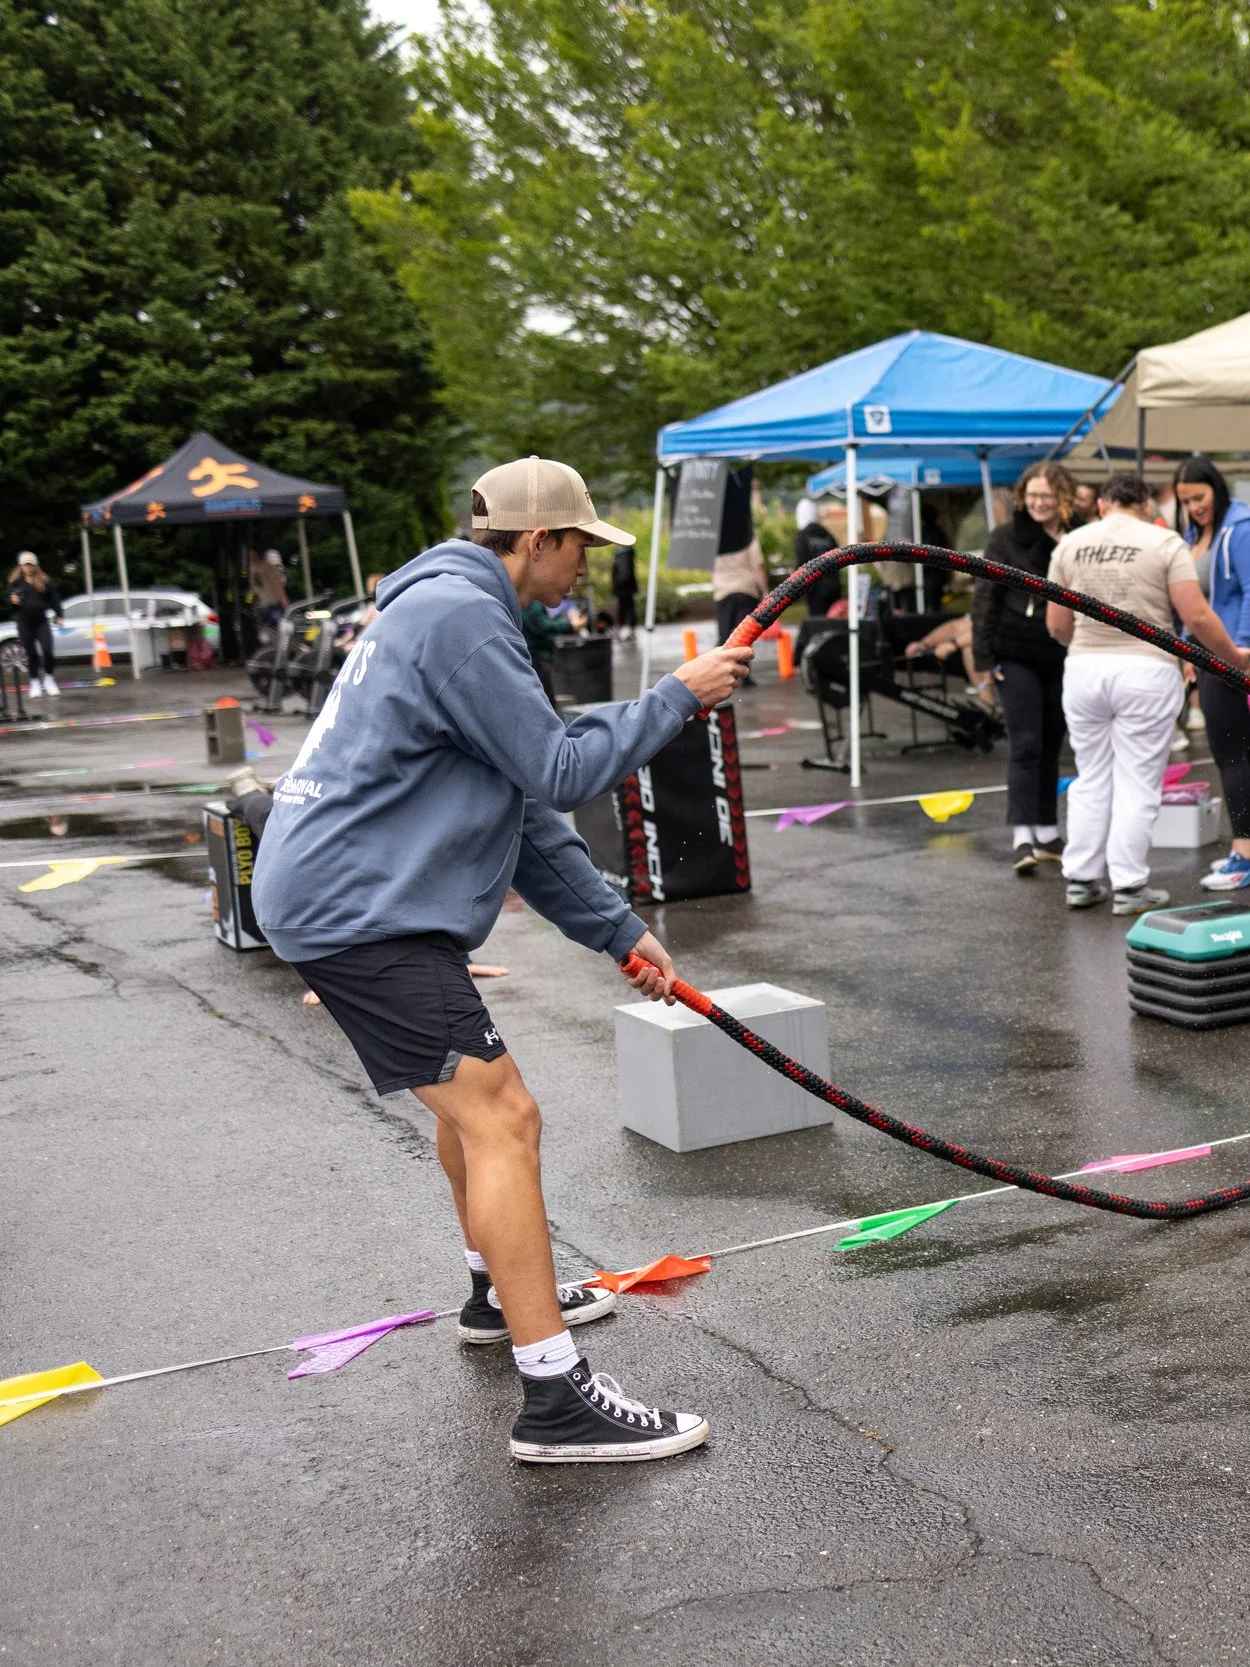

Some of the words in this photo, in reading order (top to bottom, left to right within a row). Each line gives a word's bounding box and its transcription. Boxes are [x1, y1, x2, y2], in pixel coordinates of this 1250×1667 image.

[1073, 544, 1143, 564] ATHLETE
[707, 710, 727, 789] INCH
[636, 764, 656, 813] 30
[715, 795, 734, 847] 30
[236, 850, 254, 886] PLYO
[643, 819, 666, 902] INCH
